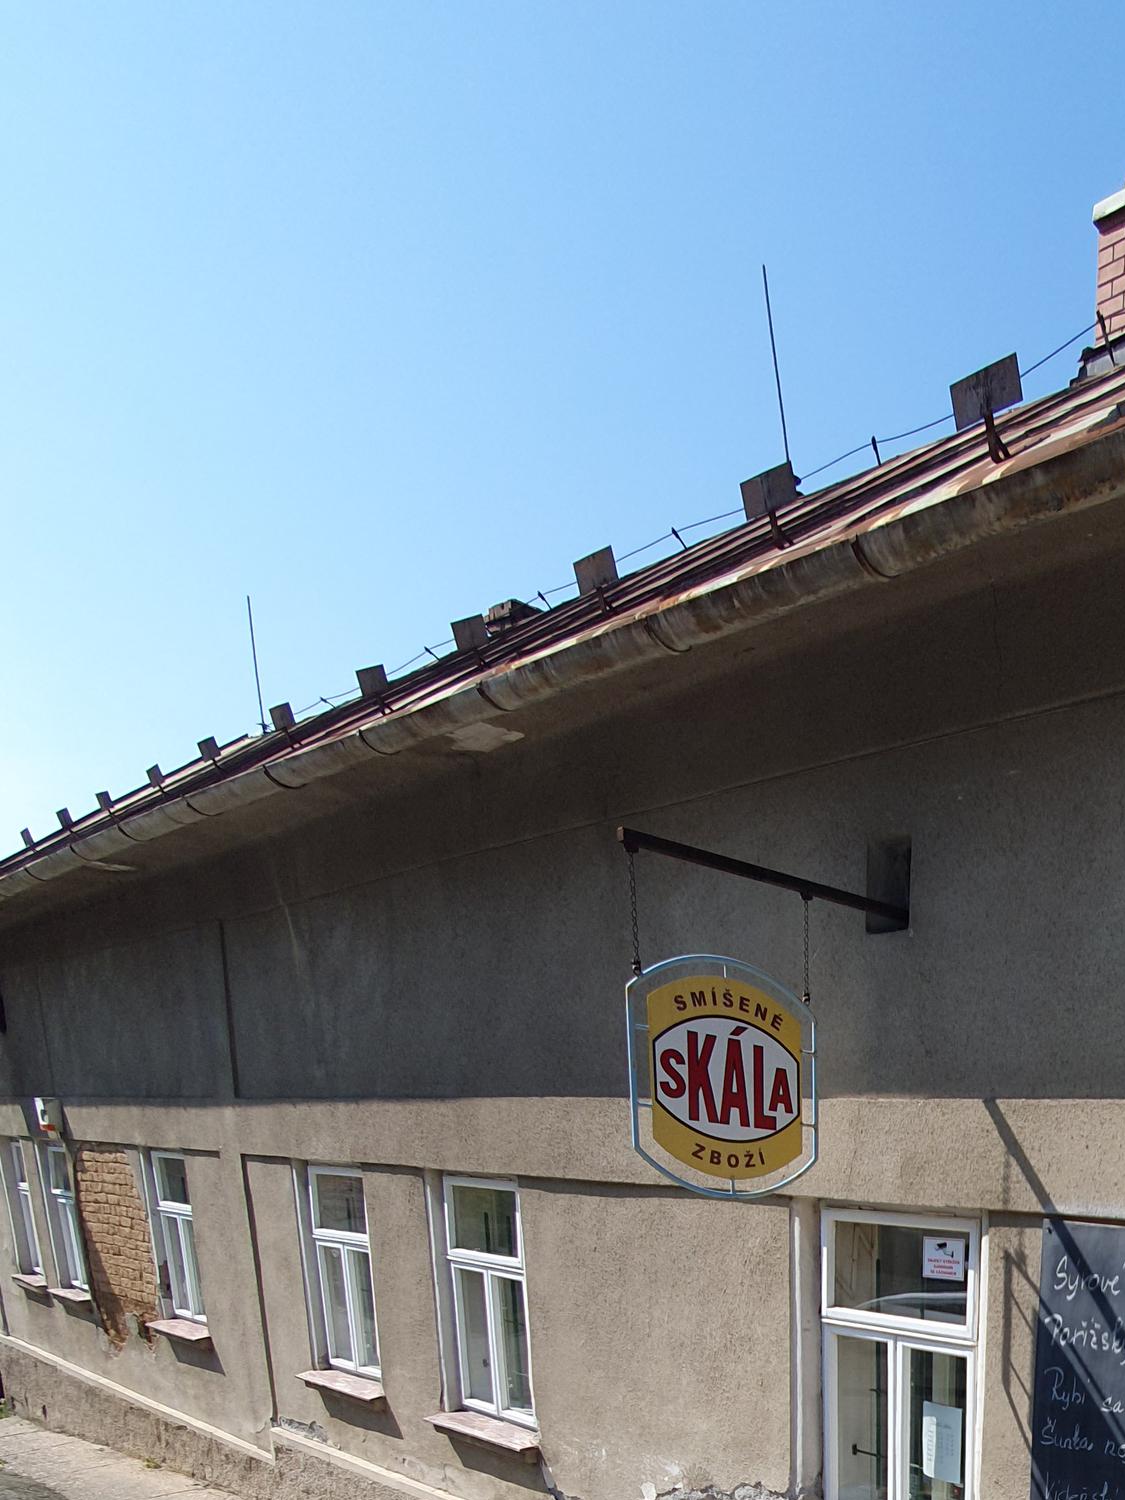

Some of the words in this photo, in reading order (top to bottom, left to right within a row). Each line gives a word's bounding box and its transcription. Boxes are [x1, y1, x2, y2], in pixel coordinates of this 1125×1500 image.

[674, 987, 784, 1032] SMÍŠENÉ
[659, 1026, 794, 1131] SKÁLA
[692, 1143, 766, 1168] ZBOŽÍ
